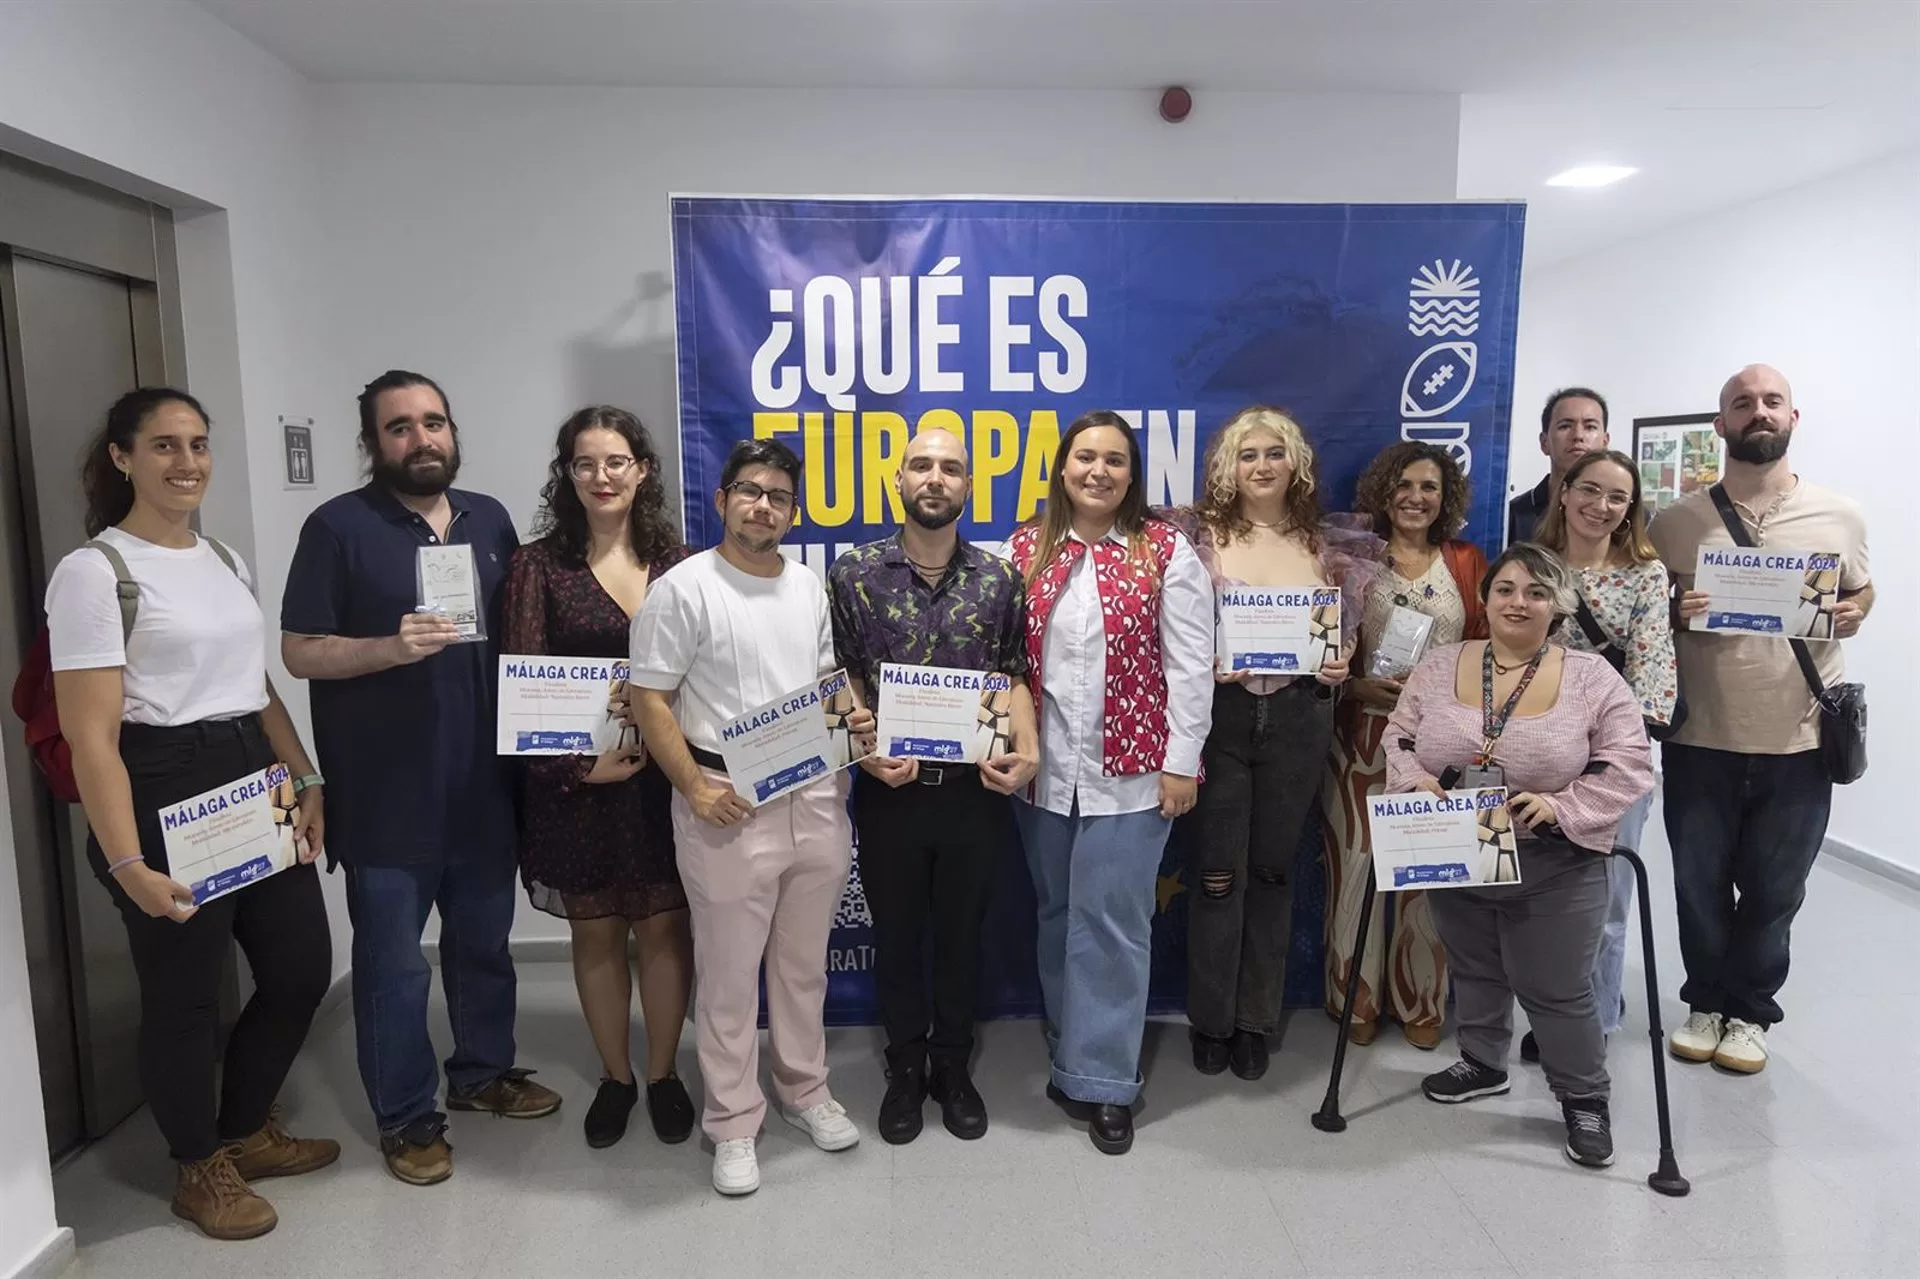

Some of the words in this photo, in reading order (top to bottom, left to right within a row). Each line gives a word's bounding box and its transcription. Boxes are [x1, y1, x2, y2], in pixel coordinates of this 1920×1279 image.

[752, 256, 964, 411] ¿QUÉ
[990, 275, 1088, 393] ES
[753, 409, 1060, 527] URPA
[1112, 410, 1196, 508] N
[1704, 551, 1761, 568] MÁLAGA
[1766, 557, 1804, 570] CREA
[1808, 557, 1837, 570] 2024
[1222, 591, 1273, 606] MÁLAGA
[1277, 595, 1310, 606] CREA
[1313, 593, 1338, 606] 2024
[506, 661, 566, 679] MÁLAGA
[570, 666, 608, 680] CREA
[612, 665, 630, 680] 202
[883, 667, 940, 687] MÁLAGA
[944, 675, 980, 690] CREA
[983, 675, 1009, 691] 2024
[722, 708, 780, 741] MÁLAGA
[782, 691, 819, 715] CREA
[820, 676, 847, 698] 2024
[164, 795, 228, 830] MÁLAGA
[230, 779, 266, 804] CREA
[266, 767, 289, 789] 2024
[1374, 800, 1432, 816] MÁLAGA
[1436, 798, 1474, 812] CREA
[1477, 793, 1506, 809] 2024
